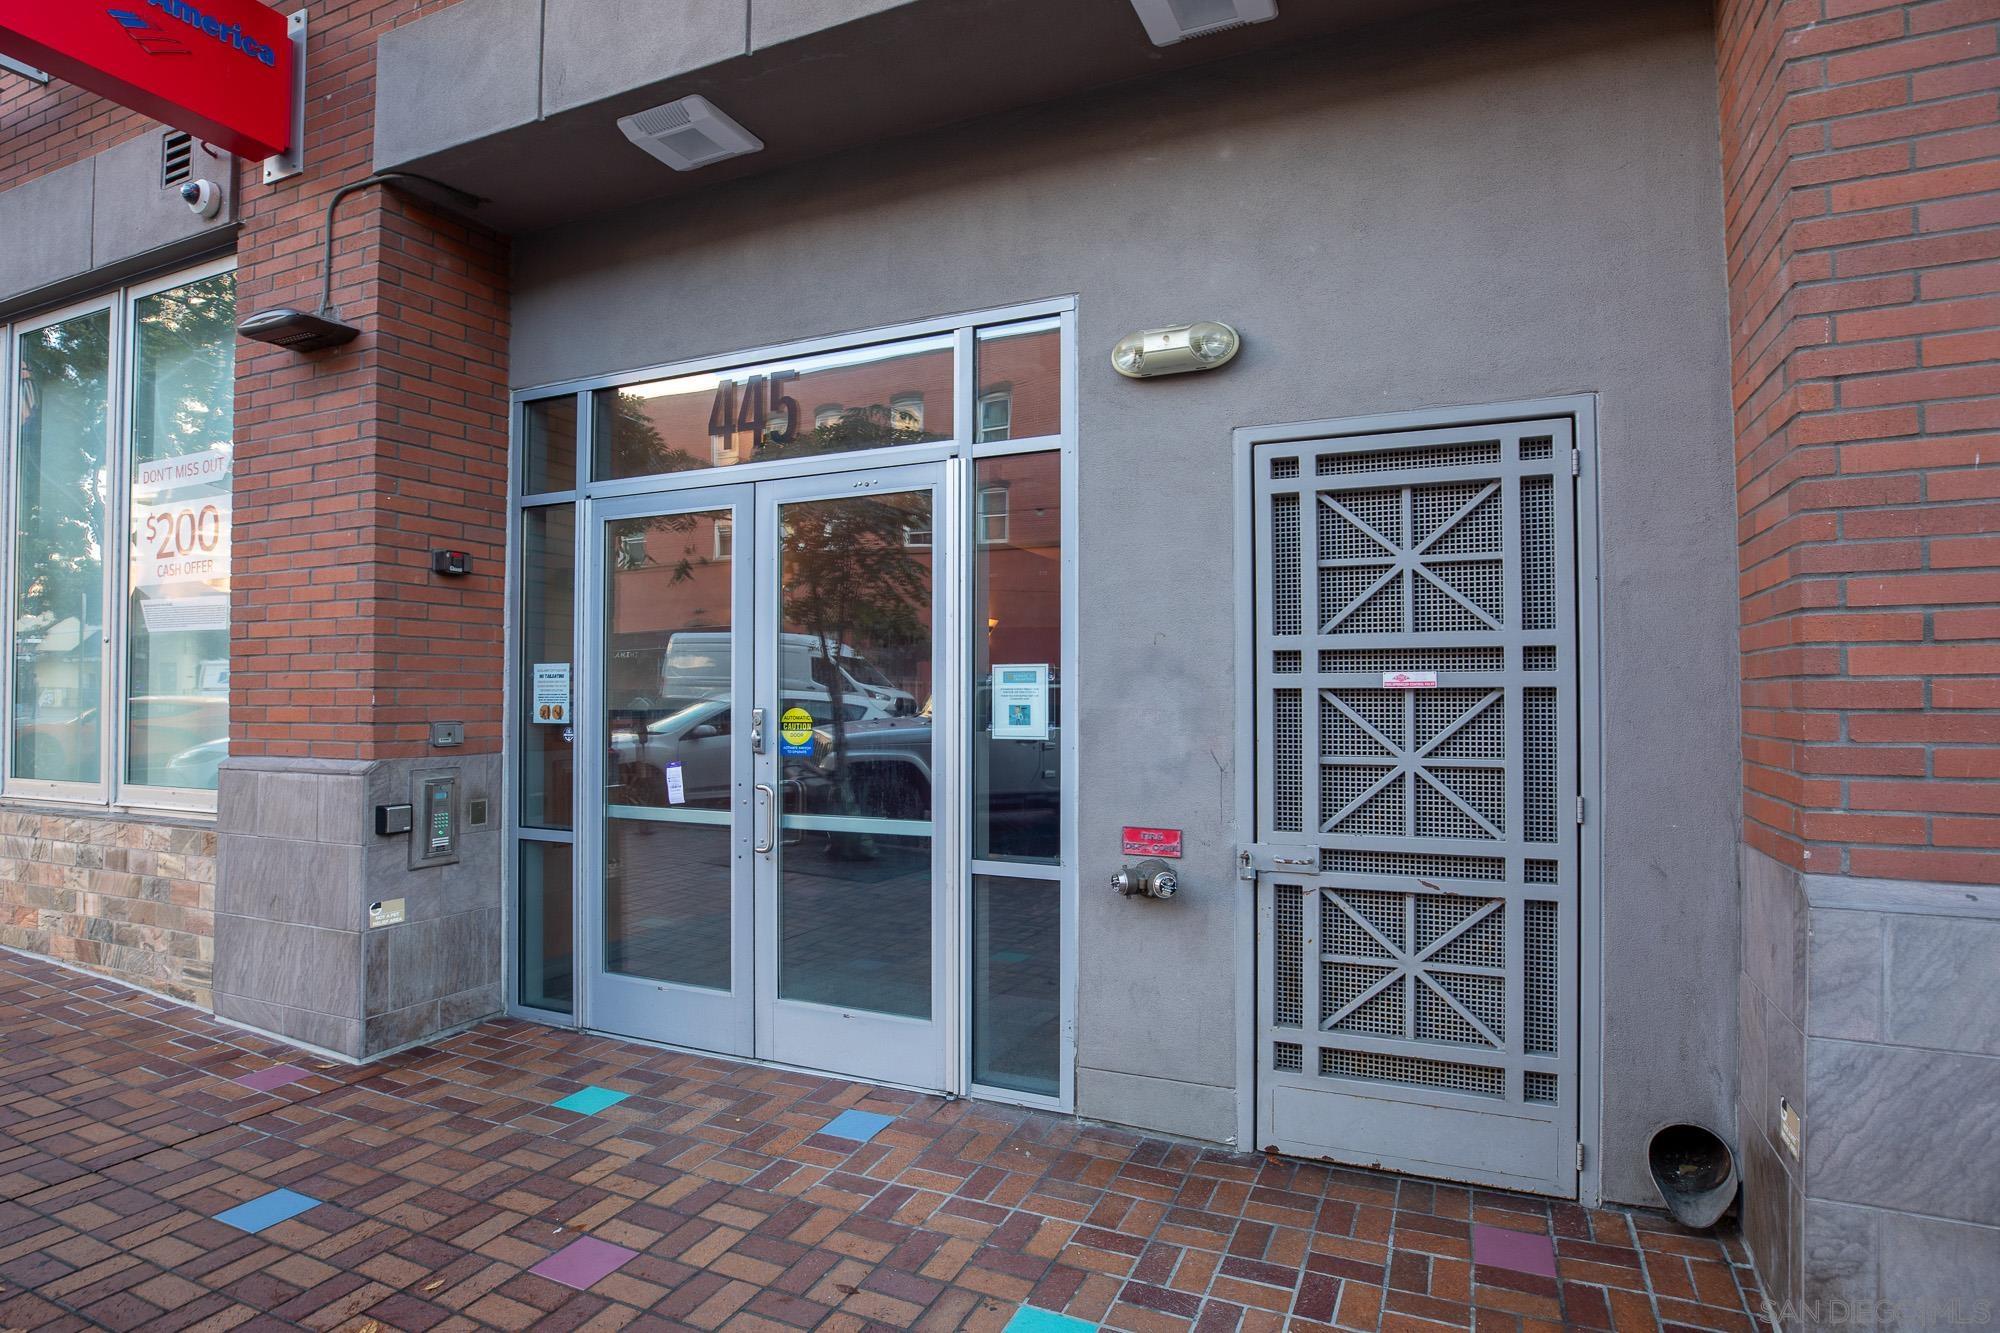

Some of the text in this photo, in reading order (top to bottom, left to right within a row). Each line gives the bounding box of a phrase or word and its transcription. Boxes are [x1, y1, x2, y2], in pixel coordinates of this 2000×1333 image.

[708, 369, 800, 450] 445
[143, 456, 225, 484] DON'T MISS OUT
[146, 504, 219, 560] $200
[157, 559, 214, 578] CASH OFFER
